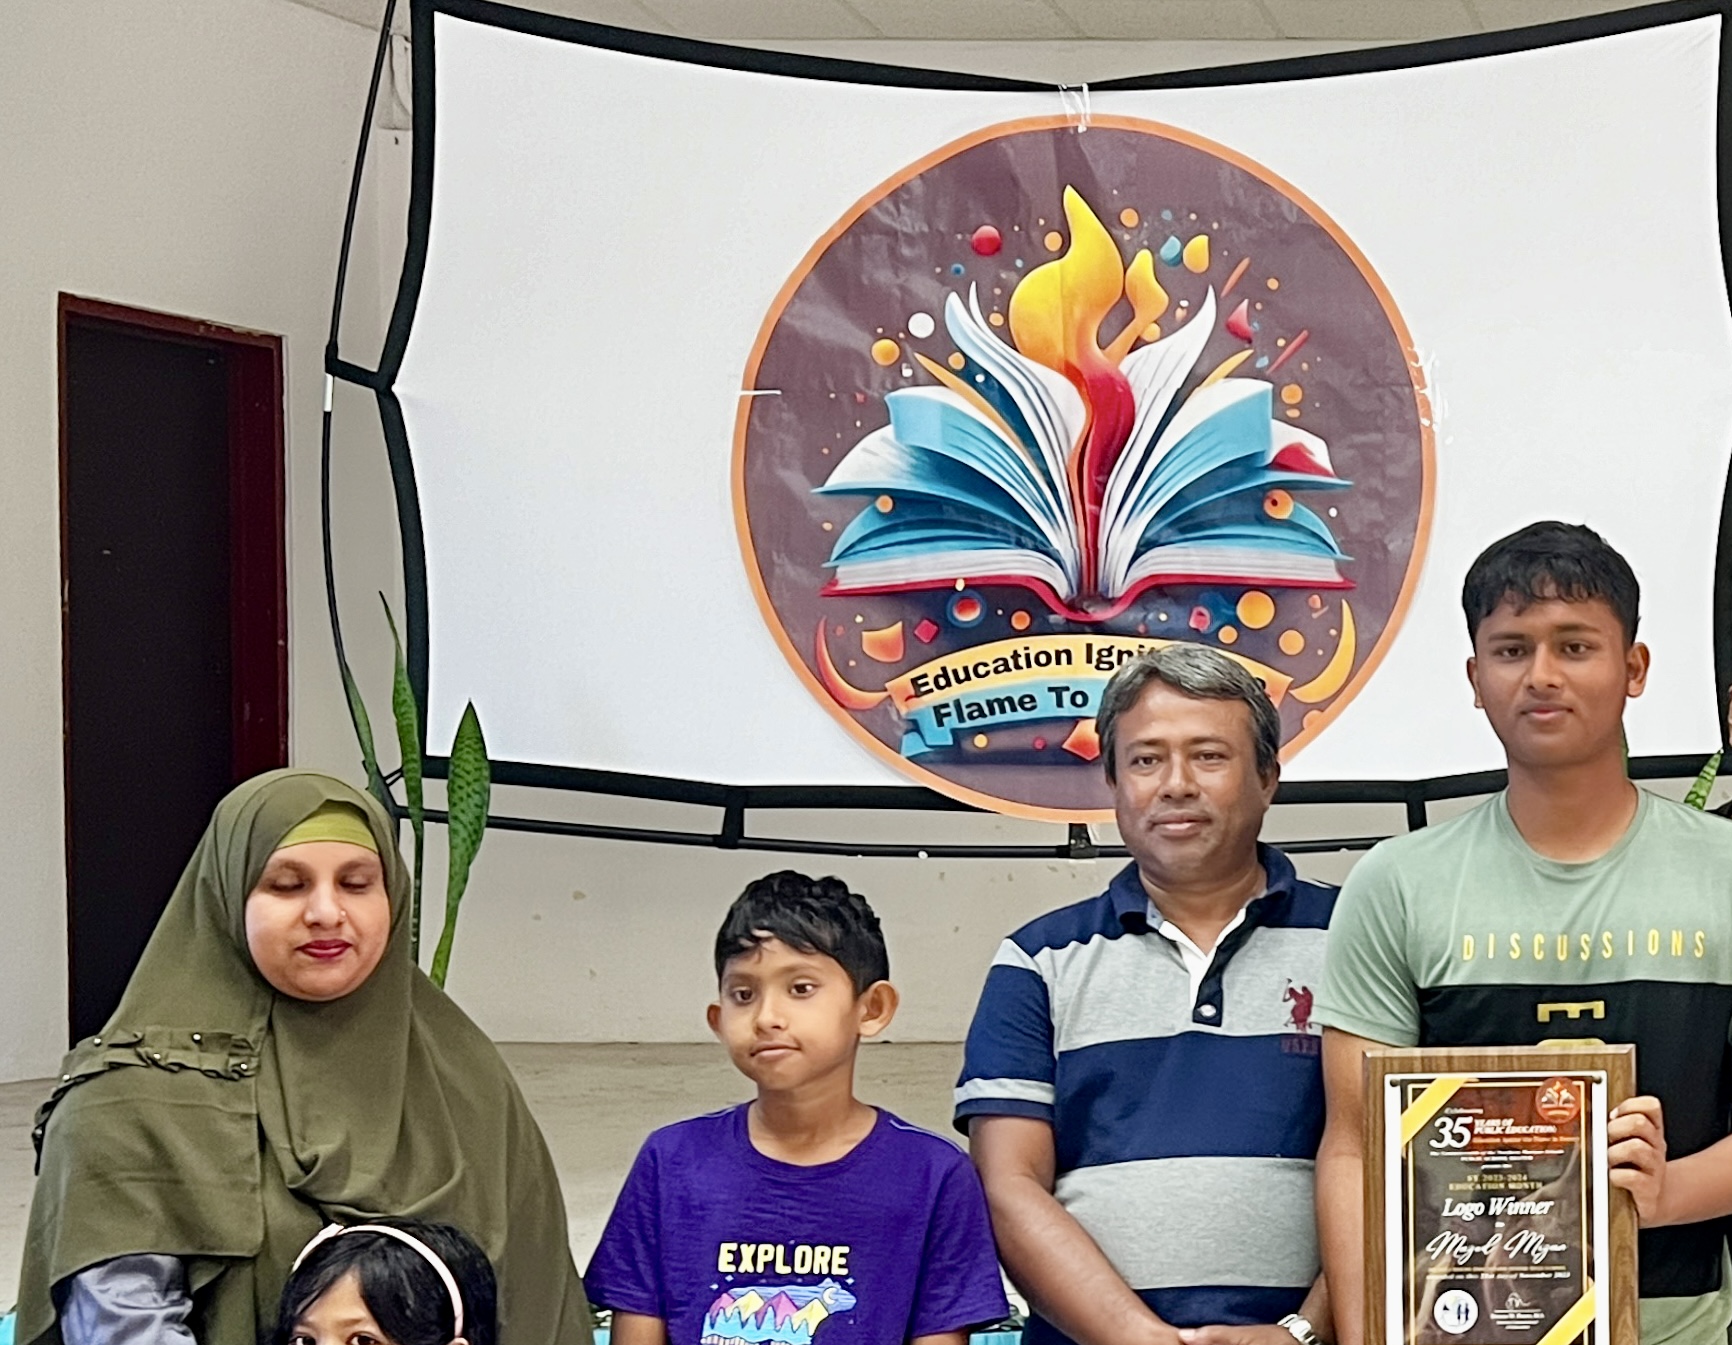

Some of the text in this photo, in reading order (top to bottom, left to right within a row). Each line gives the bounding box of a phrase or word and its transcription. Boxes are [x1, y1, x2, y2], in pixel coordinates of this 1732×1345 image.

[910, 645, 1073, 698] Education
[933, 686, 1089, 728] Flame To
[1462, 928, 1706, 961] DISCUSSIONS
[1428, 1115, 1474, 1149] 35
[1441, 1196, 1555, 1221] Logo Winner
[717, 1242, 850, 1276] EXPLORE
